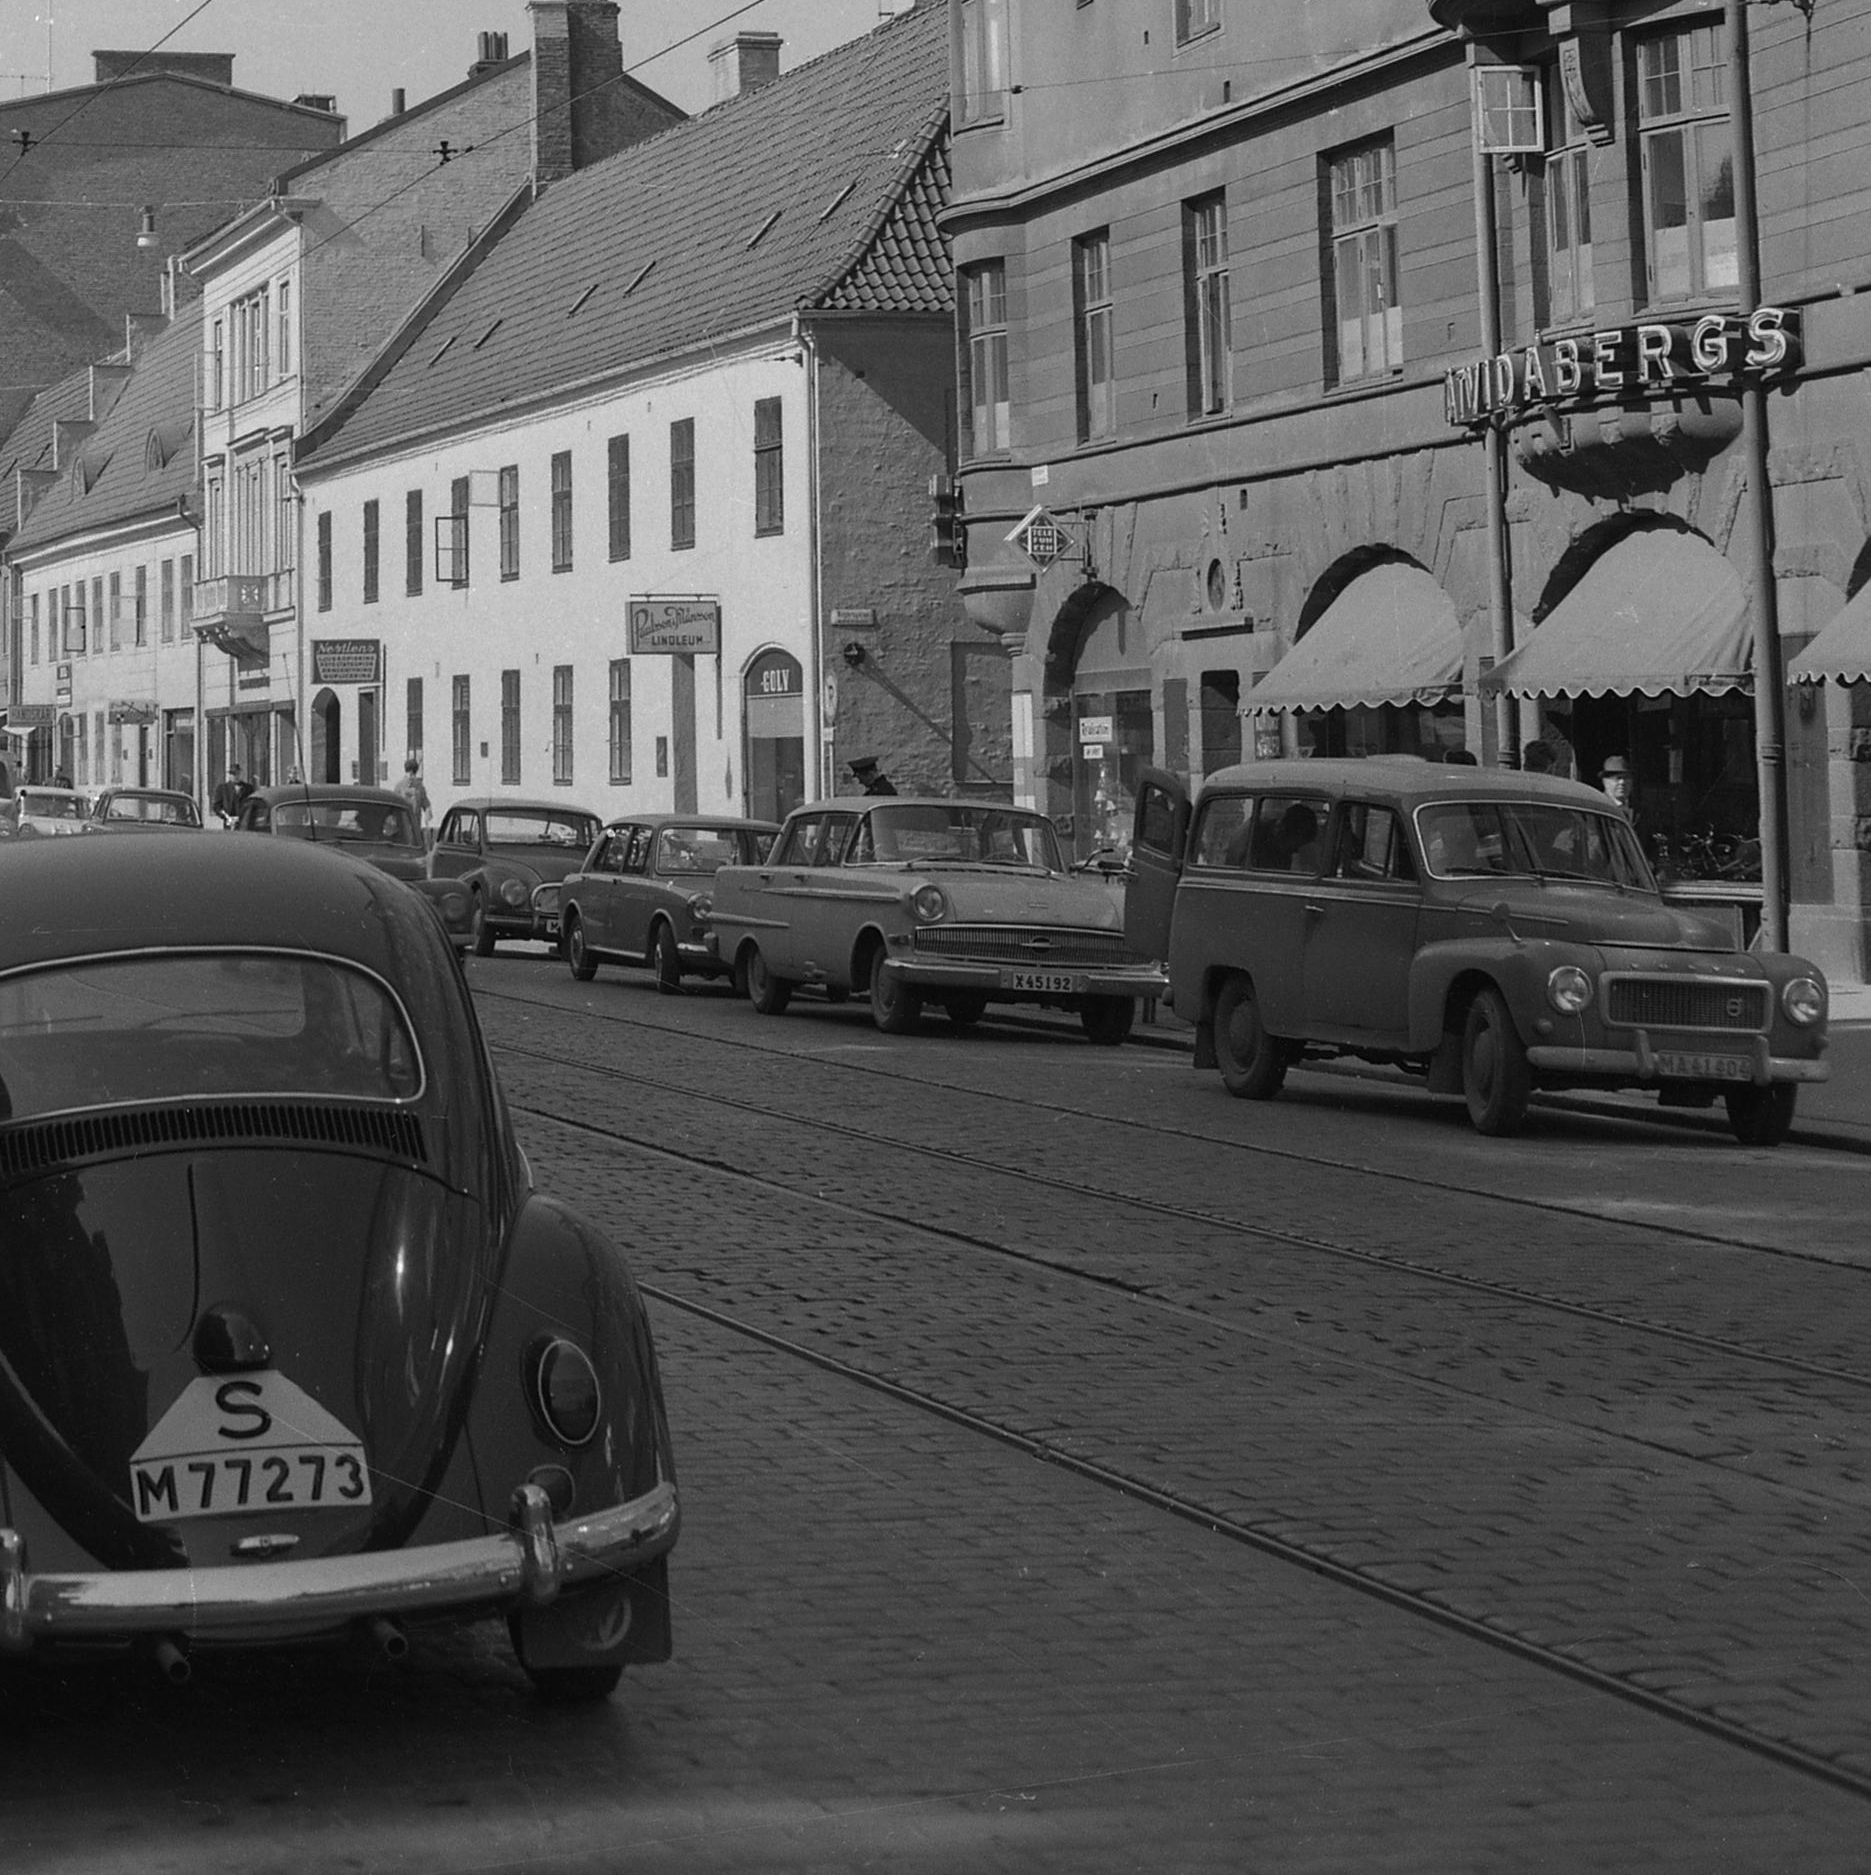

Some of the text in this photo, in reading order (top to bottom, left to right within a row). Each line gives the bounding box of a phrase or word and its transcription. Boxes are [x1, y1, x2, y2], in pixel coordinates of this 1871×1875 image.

[652, 635, 703, 646] LINOLEUM
[1015, 974, 1071, 991] X45192
[216, 1381, 271, 1439] S
[137, 1456, 364, 1515] M77273
